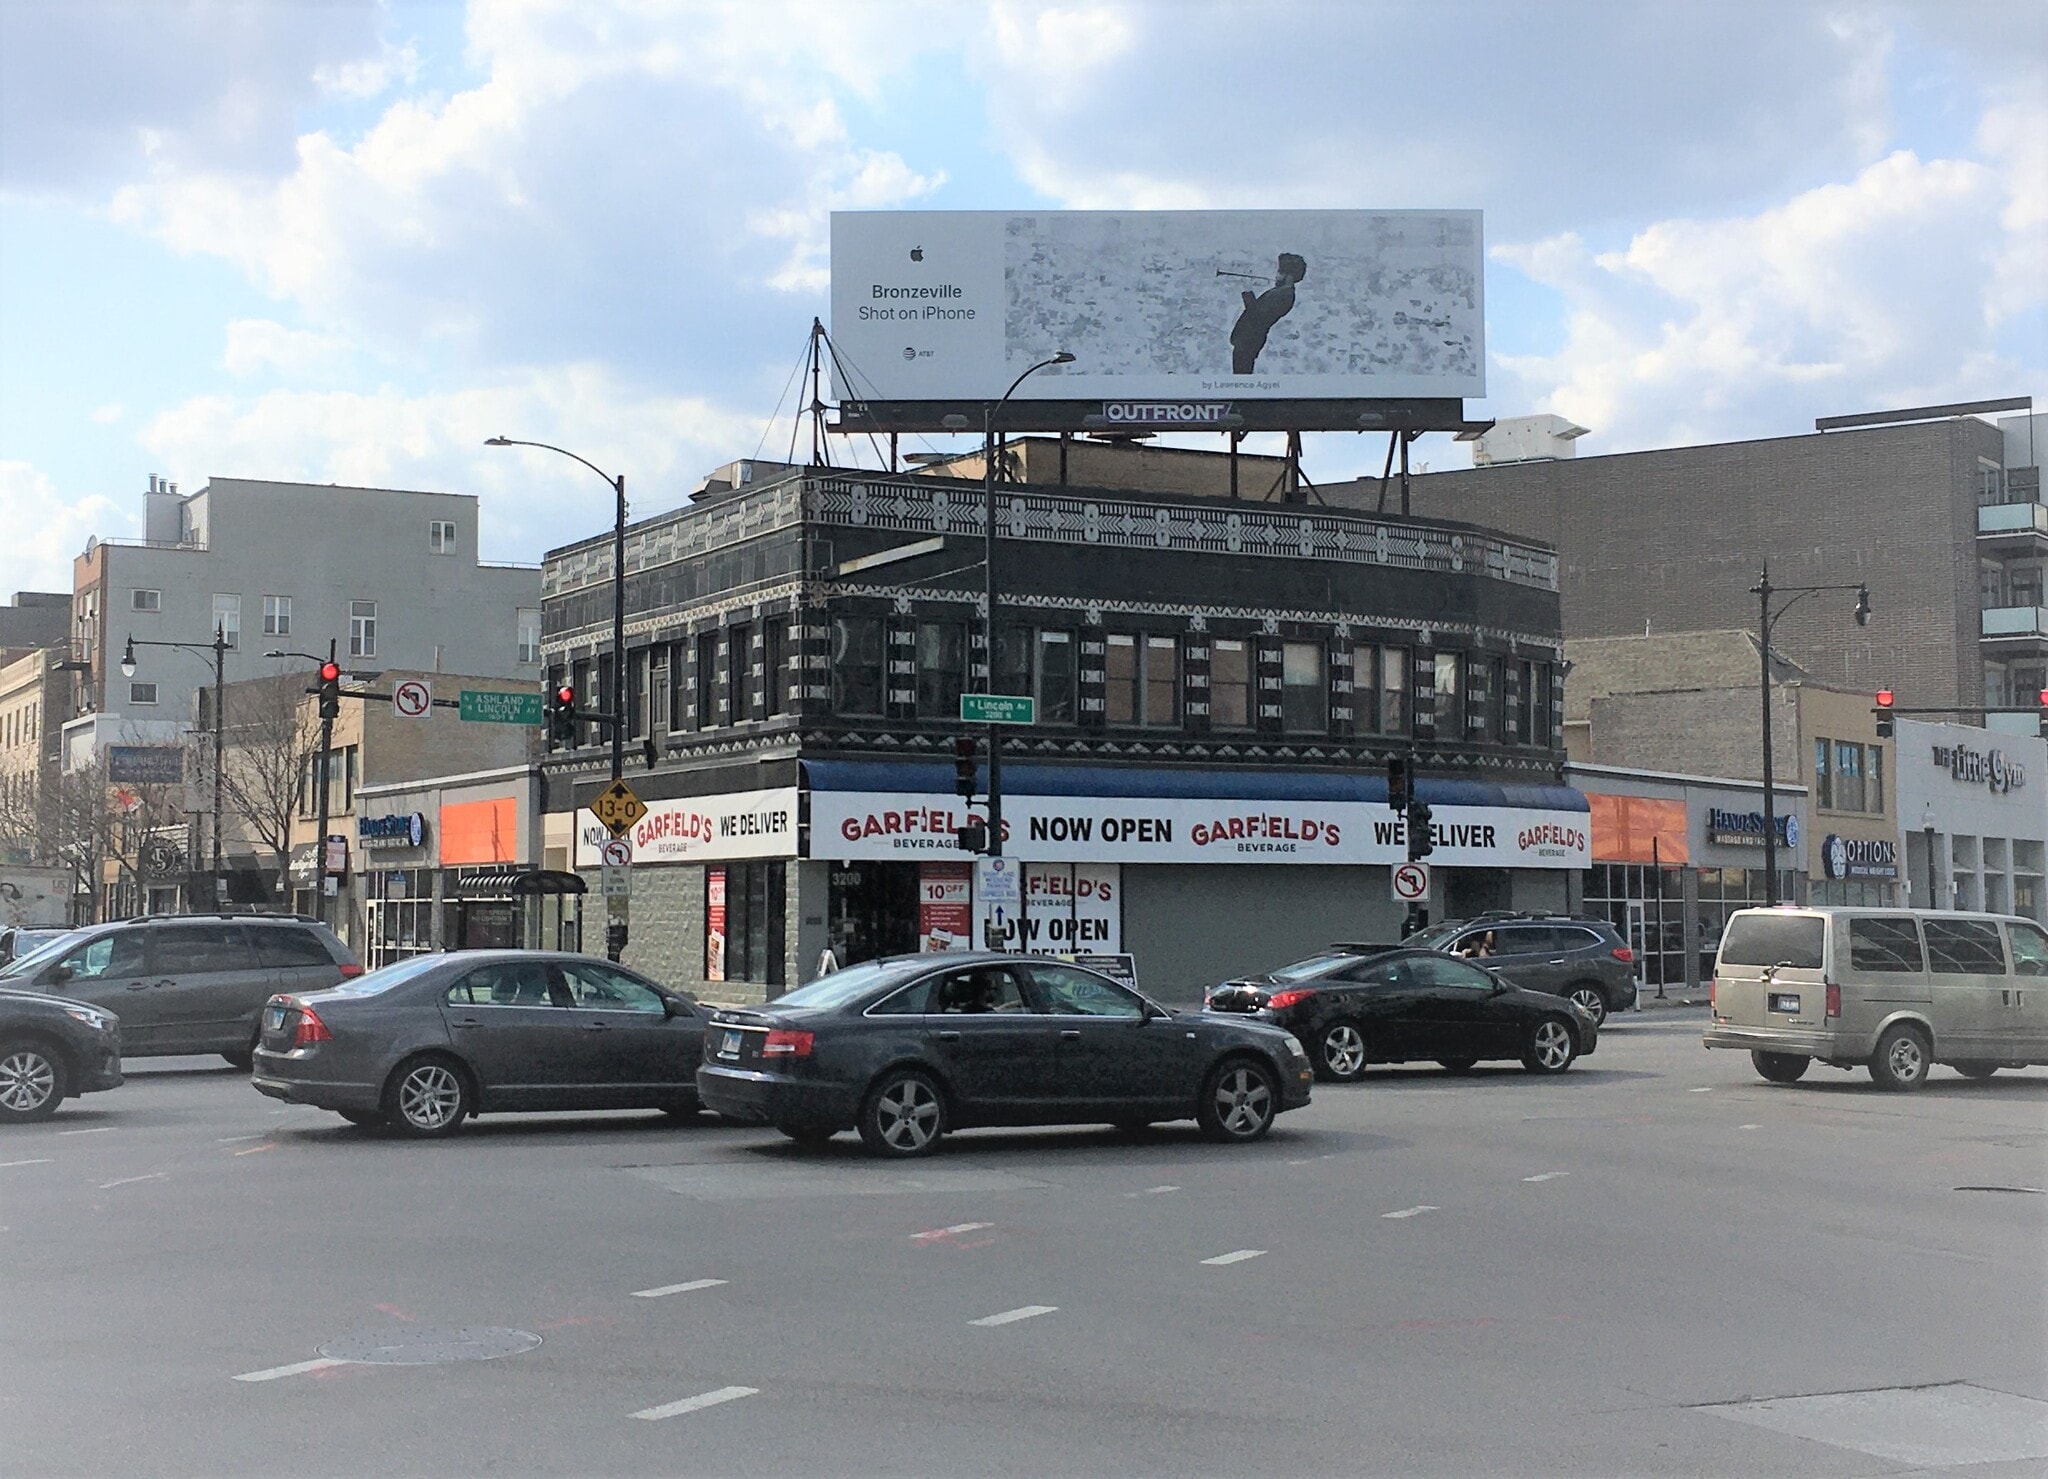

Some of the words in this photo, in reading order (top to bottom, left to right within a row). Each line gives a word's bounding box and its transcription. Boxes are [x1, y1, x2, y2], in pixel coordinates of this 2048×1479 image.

[872, 284, 962, 299] Bronzeville
[859, 306, 895, 320] Shot
[898, 309, 918, 320] on
[922, 306, 976, 320] iPhone
[1202, 381, 1212, 390] by
[1214, 381, 1255, 389] Lawrence
[1107, 404, 1225, 421] OUTFRONT
[476, 694, 524, 705] ASHLAND
[977, 699, 1014, 711] Lincoln
[477, 703, 520, 714] LINCOLN
[637, 808, 713, 848] GARFIELD'S
[720, 815, 737, 837] WE
[740, 810, 788, 834] DELIVER
[1029, 816, 1093, 841] NOW
[1101, 818, 1172, 843] OPEN
[1190, 811, 1341, 847] GARFIELD'S
[1374, 821, 1405, 845] WE
[1428, 823, 1496, 848] ELIVER
[1518, 820, 1585, 852] GARFIELD'S
[658, 842, 688, 853] BEVERAGE
[893, 839, 960, 848] BEVERAGE
[1237, 843, 1296, 853] BEVERAGE
[1847, 840, 1896, 862] OPTIONS
[945, 884, 964, 893] OFF
[1048, 919, 1108, 940] OPEN
